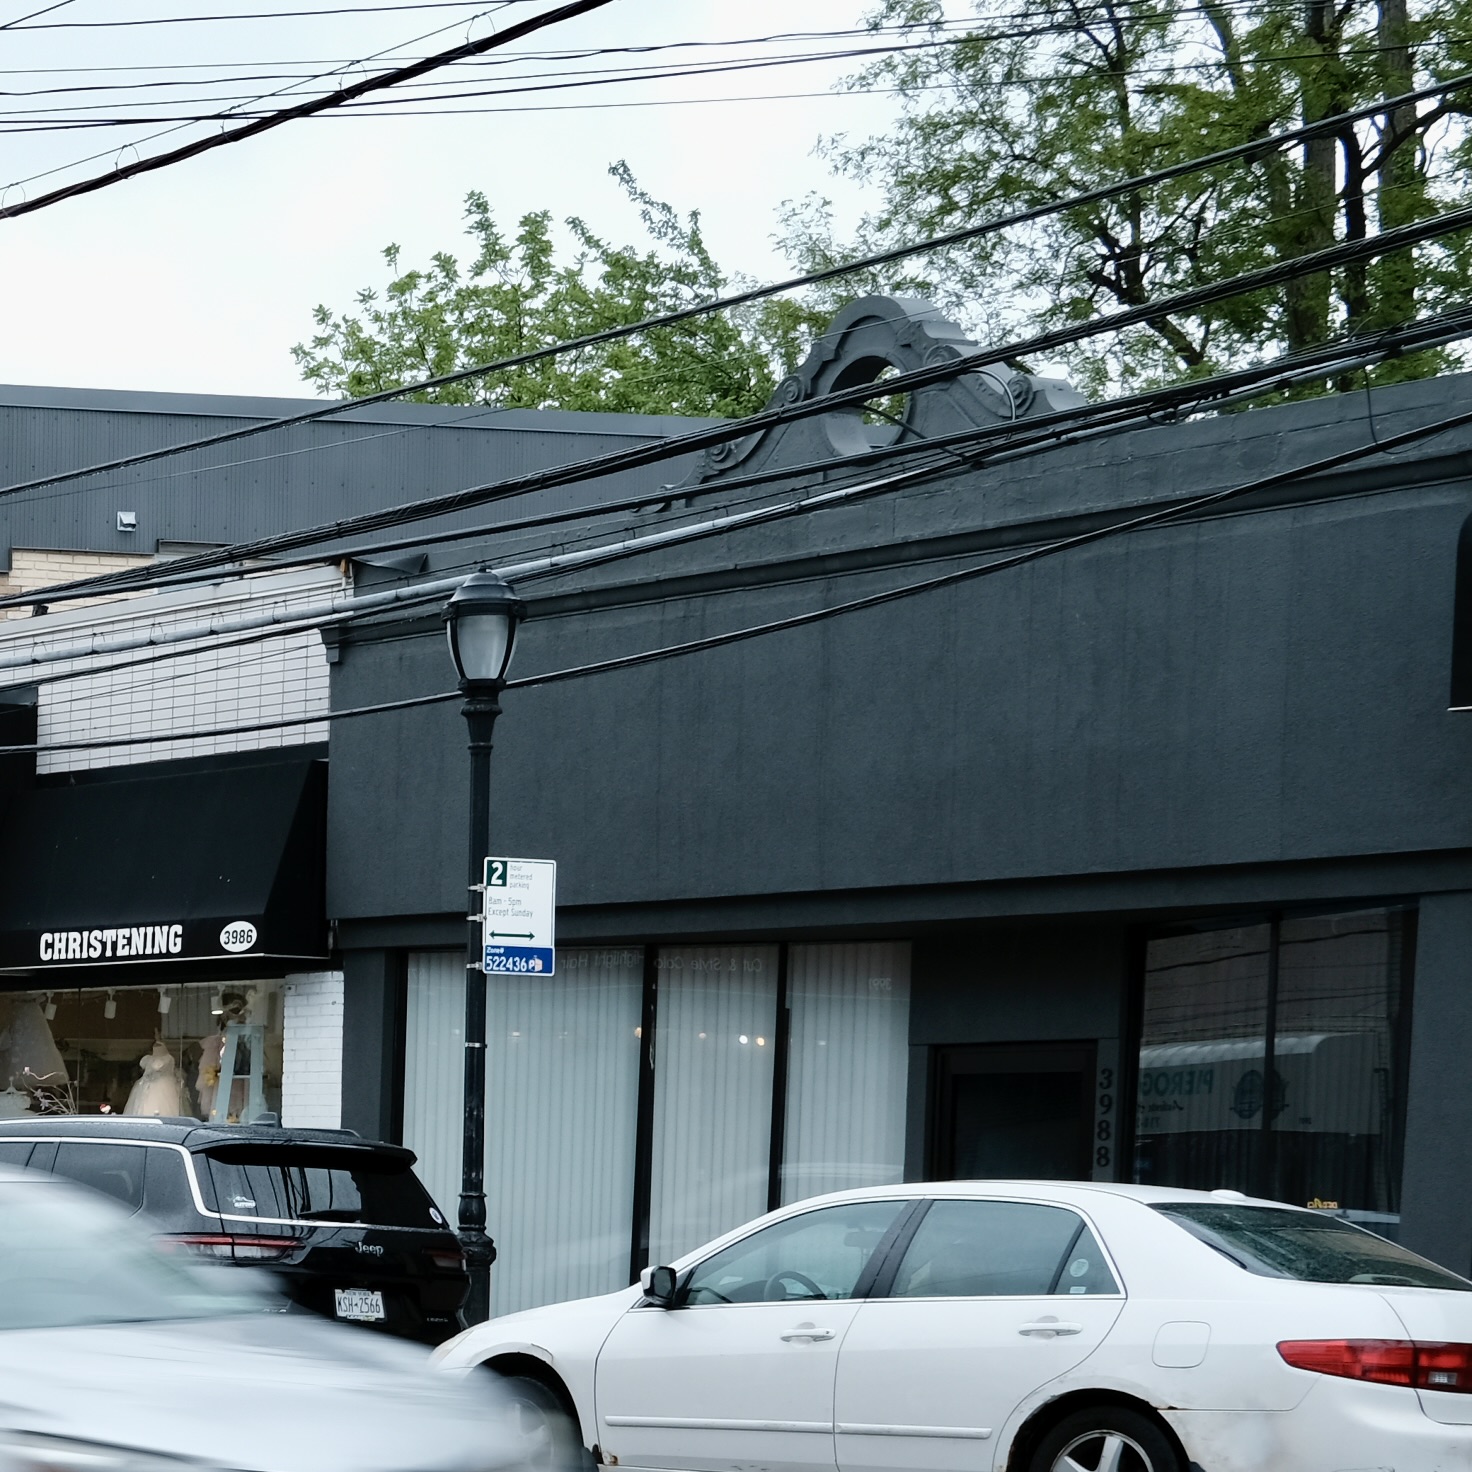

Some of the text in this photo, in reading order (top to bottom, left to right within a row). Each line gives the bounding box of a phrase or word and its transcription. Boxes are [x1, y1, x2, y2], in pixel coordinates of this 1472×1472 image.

[491, 861, 503, 885] 2
[488, 908, 533, 918] Except Sunday
[39, 924, 183, 961] CHRISTENING
[223, 929, 253, 945] 3986
[486, 956, 528, 971] 522436
[1096, 1068, 1113, 1168] 3988
[355, 1241, 384, 1256] Jeep
